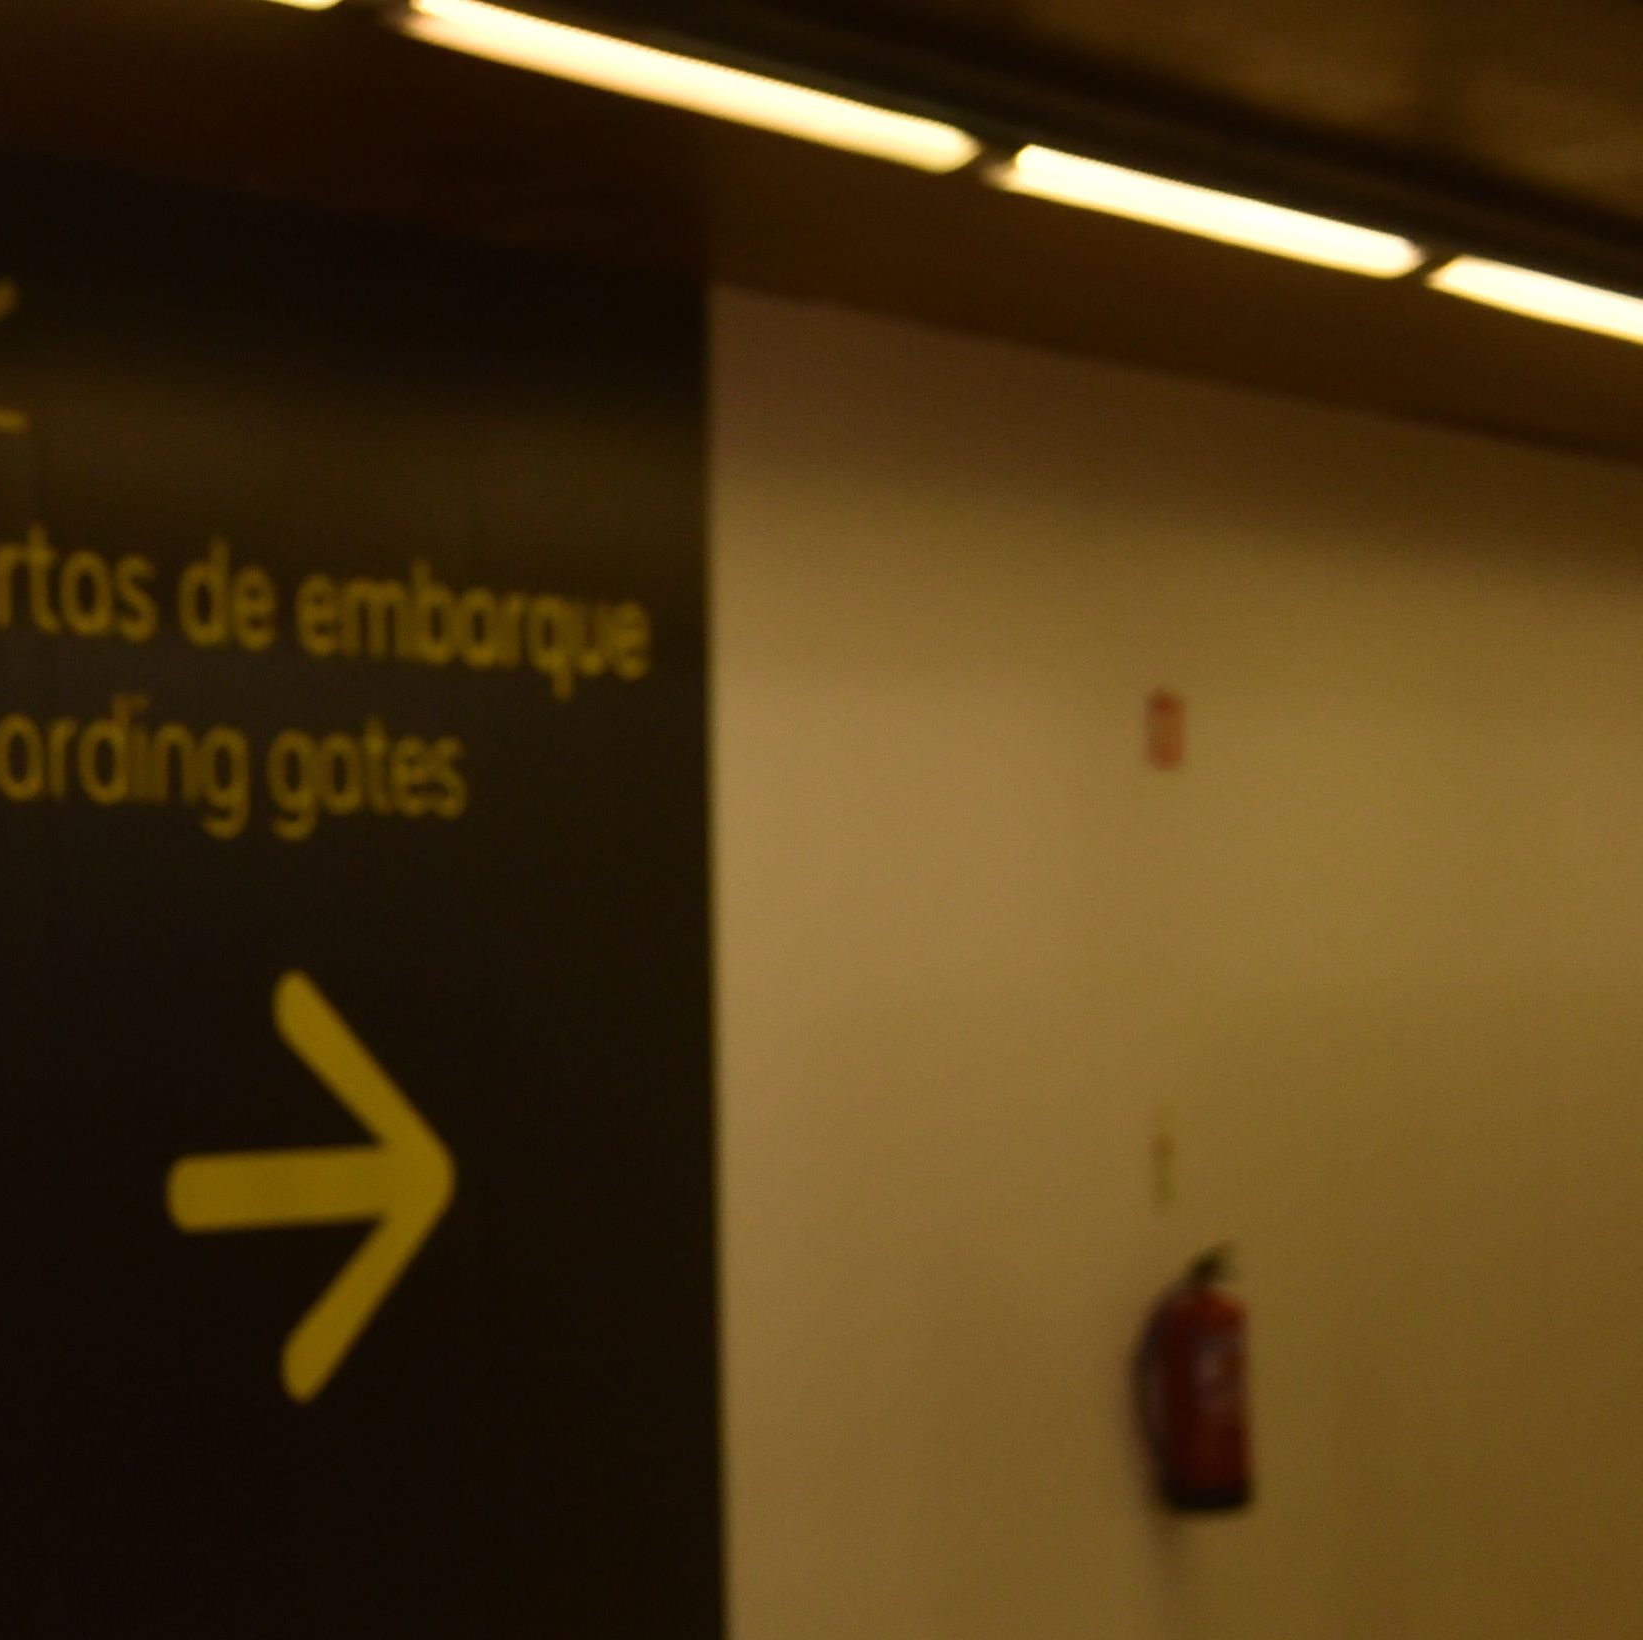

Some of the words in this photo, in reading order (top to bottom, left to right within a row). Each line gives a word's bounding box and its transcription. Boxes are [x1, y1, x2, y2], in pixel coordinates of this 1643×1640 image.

[179, 535, 278, 652] de
[294, 560, 650, 700] embarque
[266, 717, 467, 841] gates
